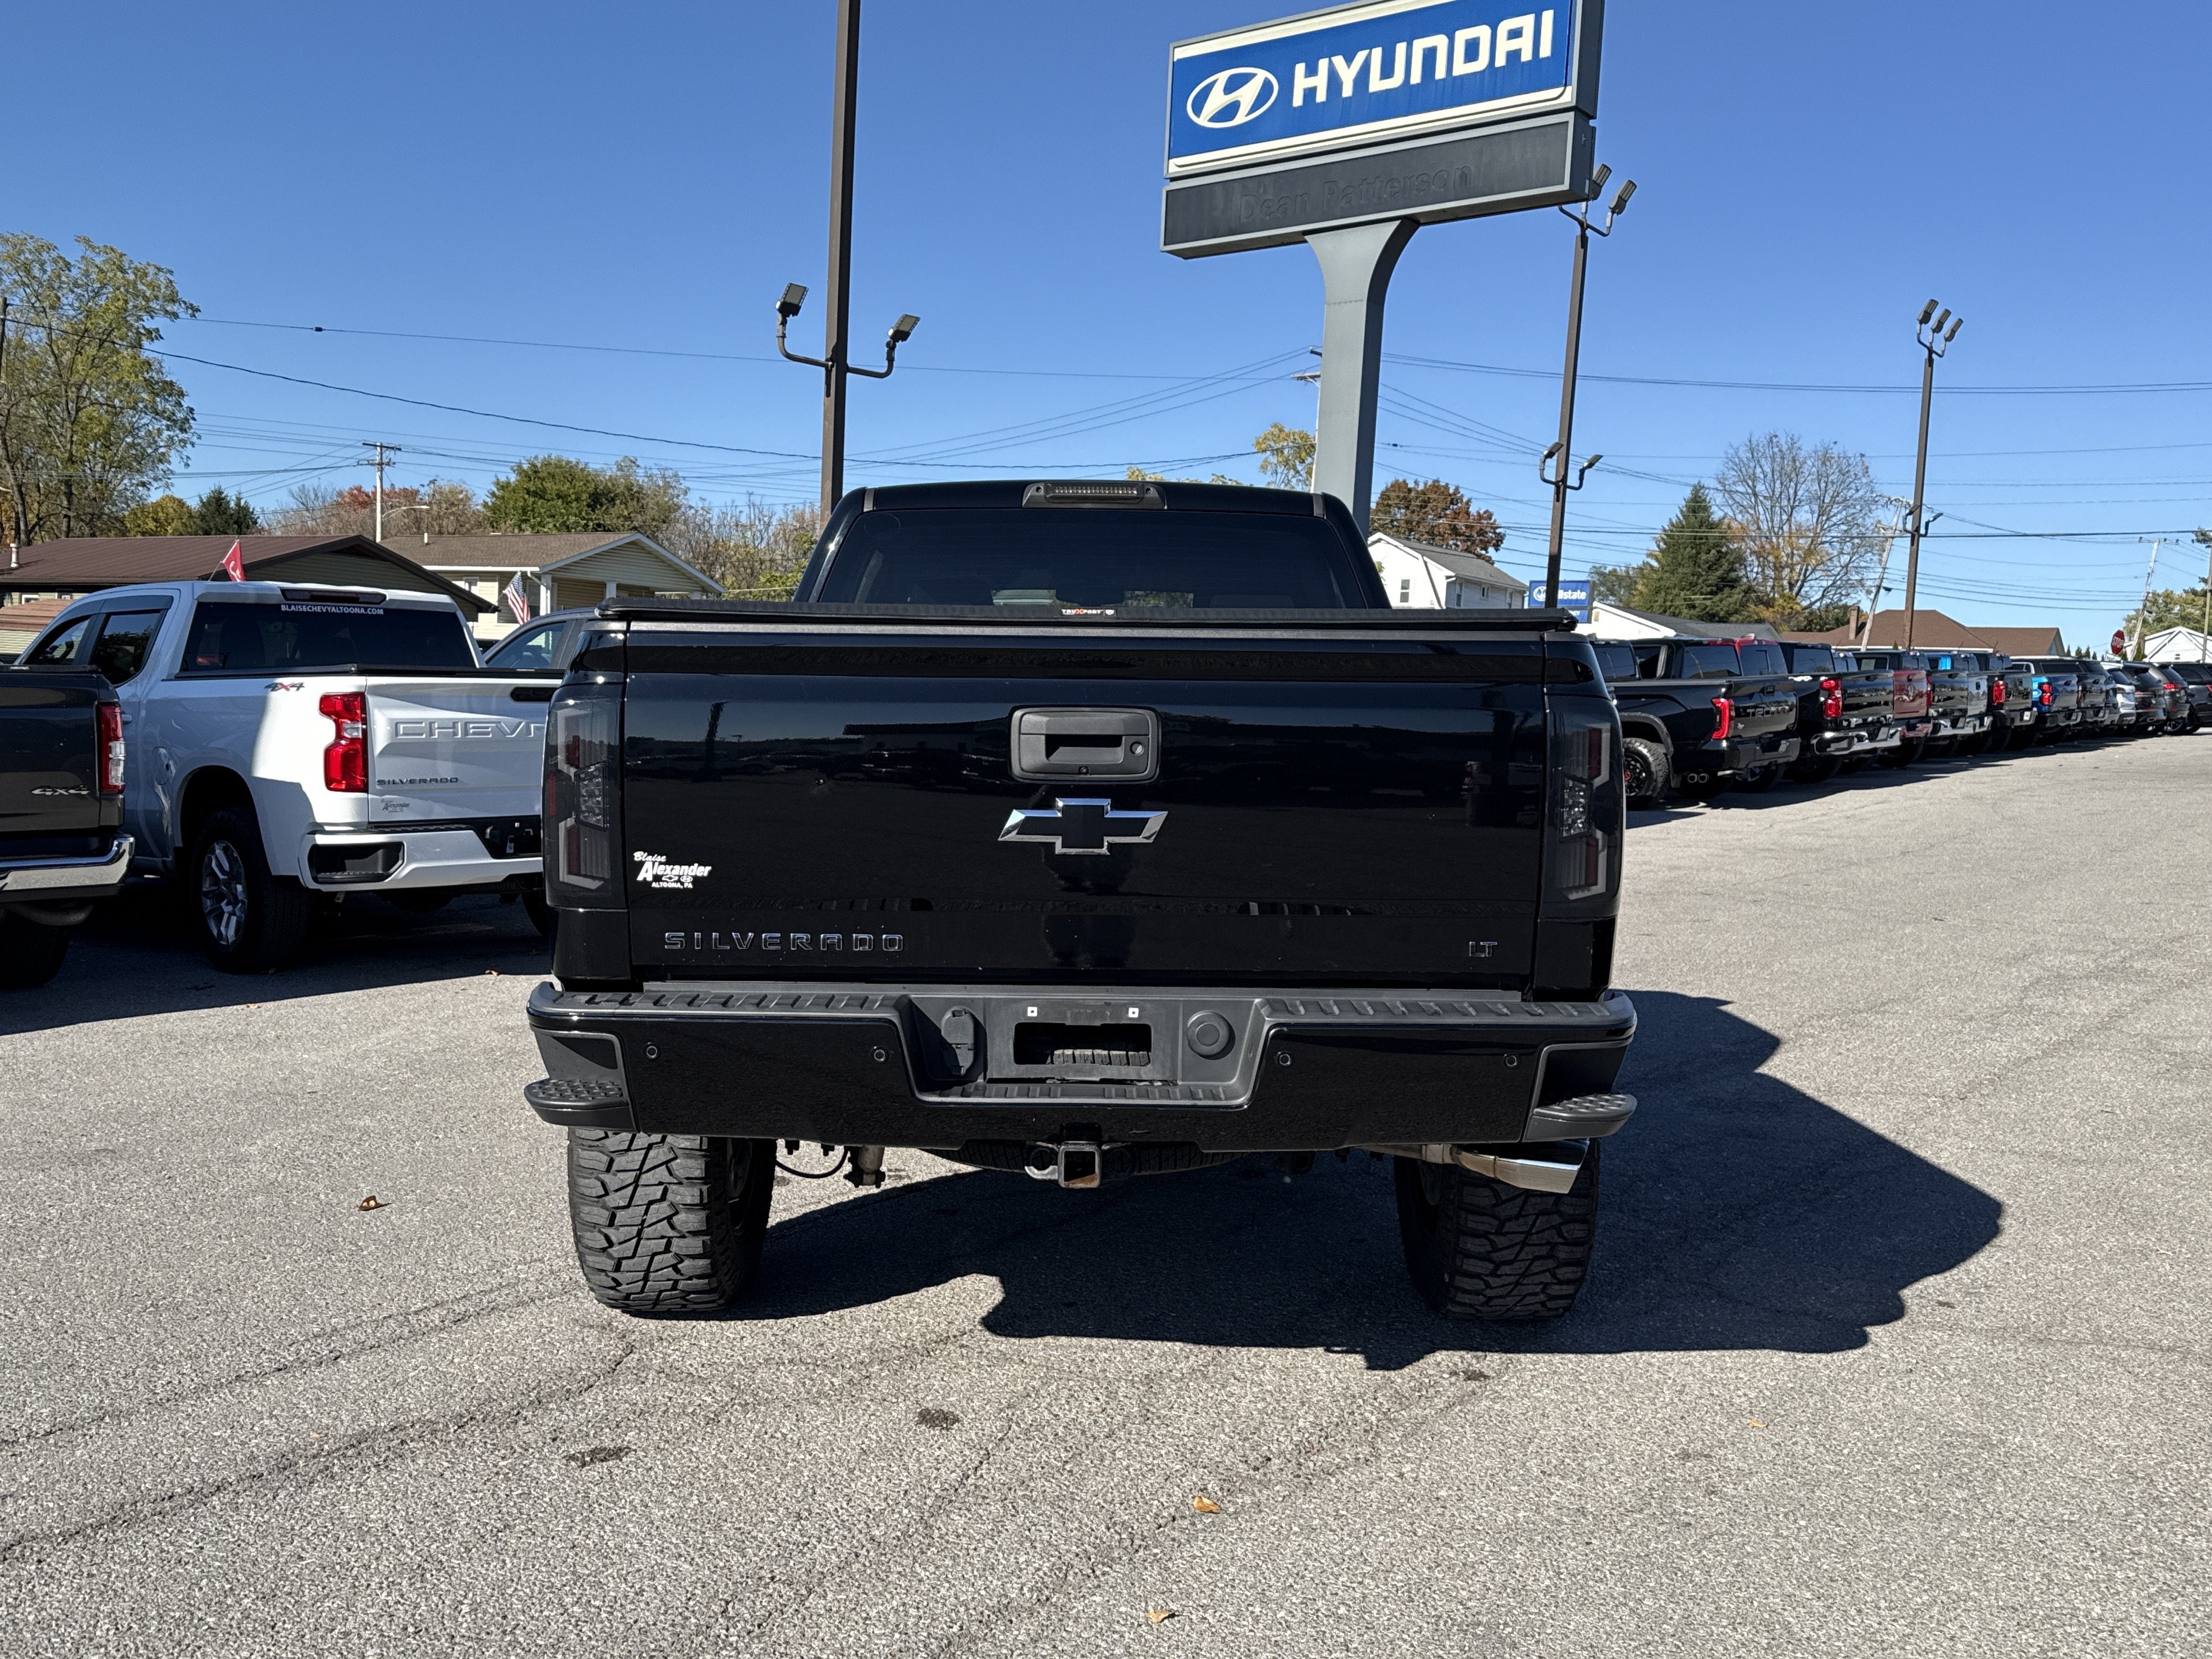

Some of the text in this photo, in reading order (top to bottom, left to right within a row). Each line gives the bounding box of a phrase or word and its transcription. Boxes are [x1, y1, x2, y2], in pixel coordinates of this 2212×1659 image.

[1293, 9, 1555, 108] HYUNDAI
[1240, 165, 1473, 223] Dean Patterson
[1558, 589, 1587, 600] llstate
[280, 604, 384, 615] BLAISECHEVYALTOONA.COM
[2112, 636, 2124, 648] STOP
[376, 777, 459, 786] SILVERADO
[633, 851, 667, 862] Blaise
[636, 861, 712, 881] Alexander
[664, 932, 905, 951] SILVERADO
[1469, 941, 1498, 957] LT
